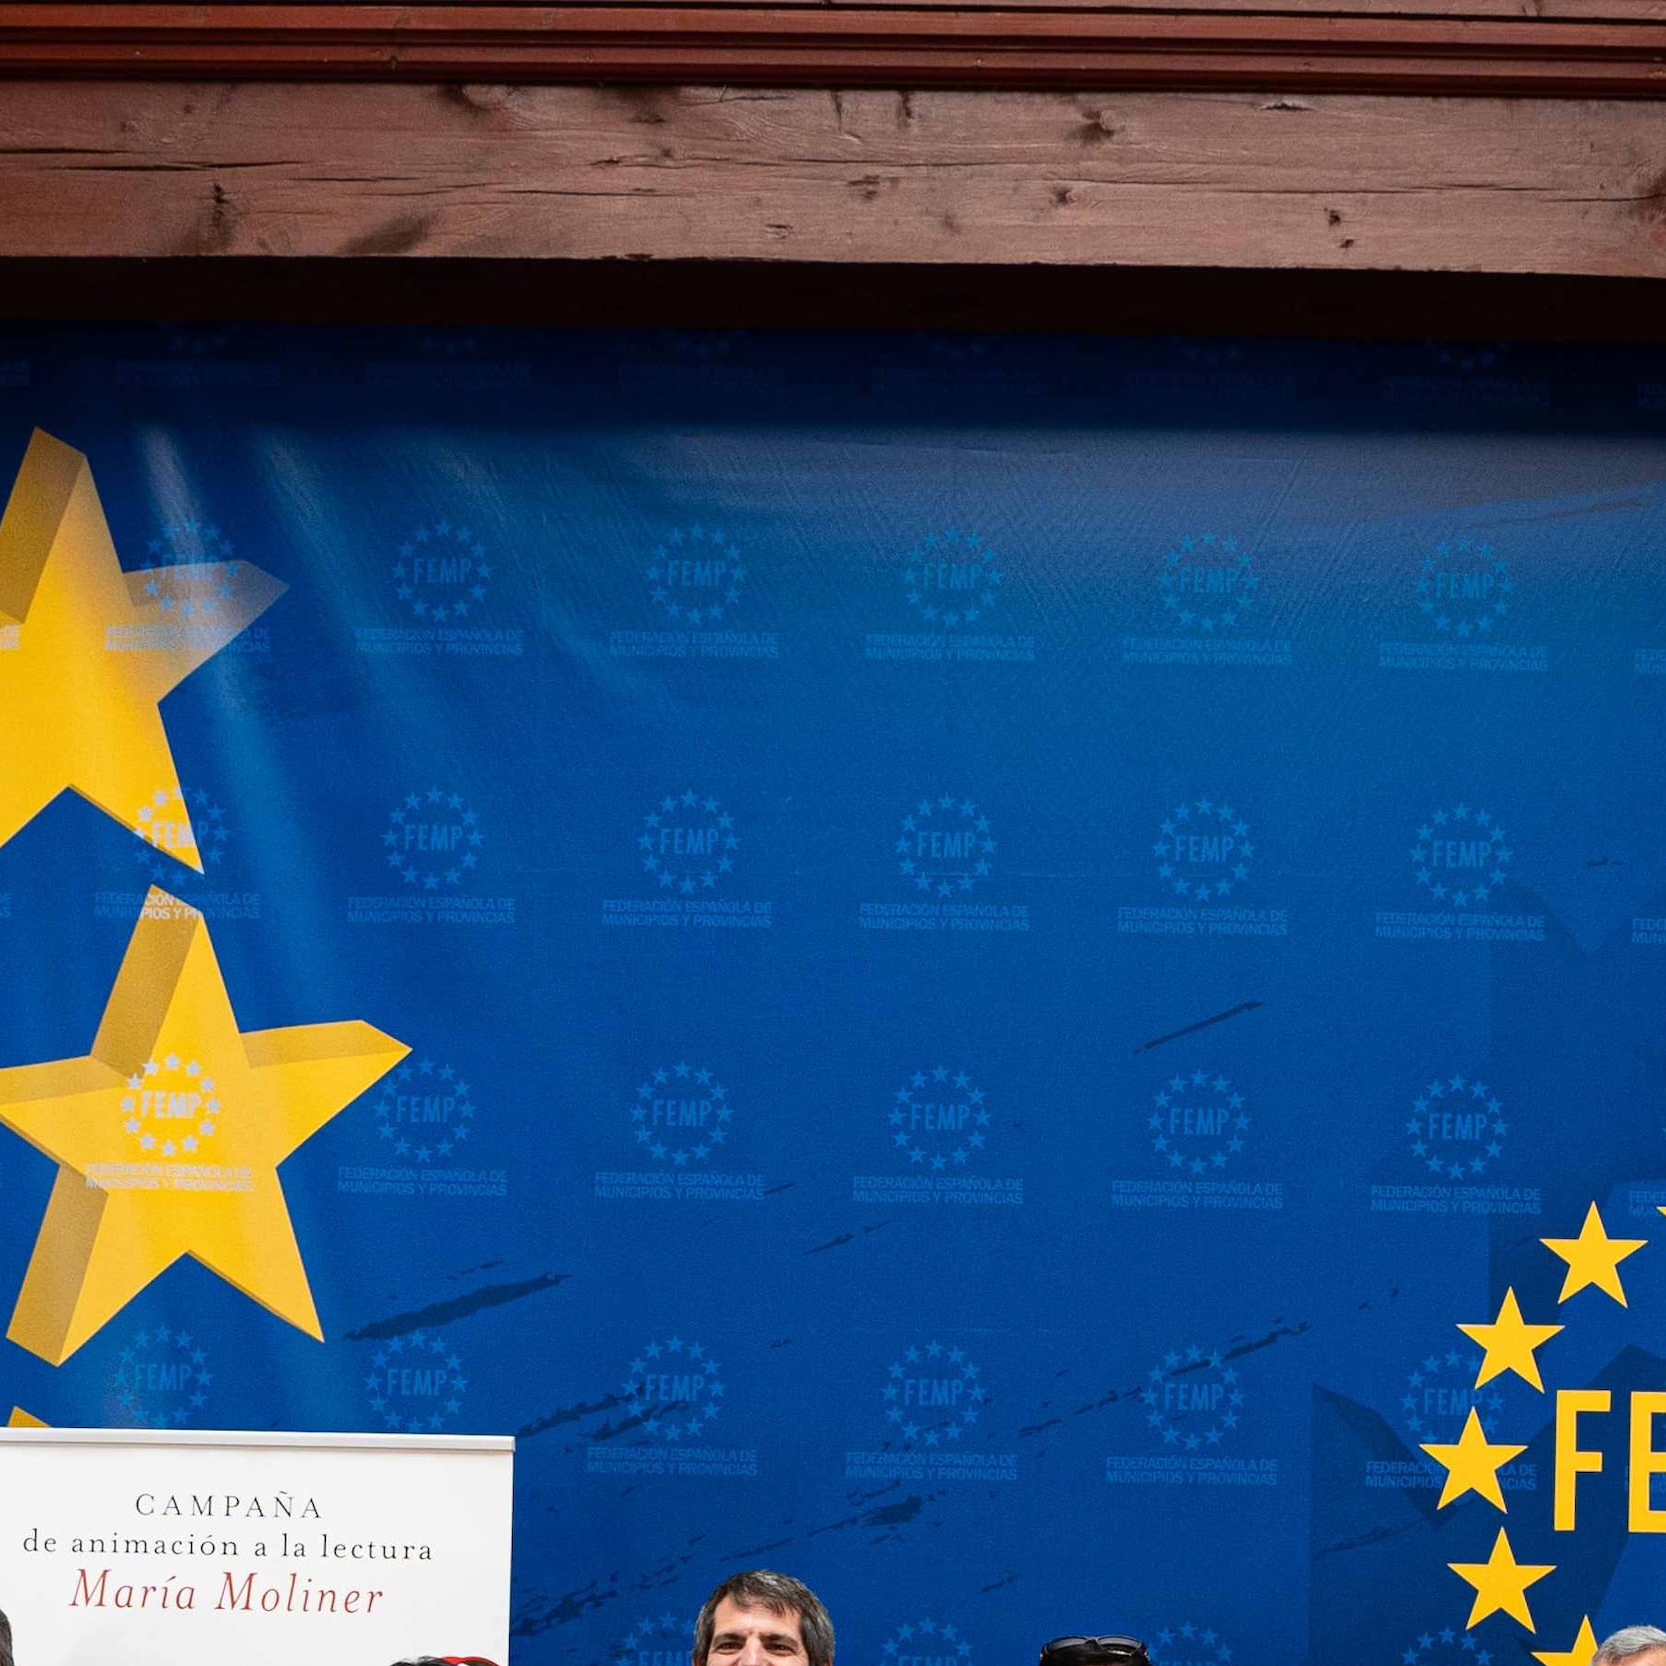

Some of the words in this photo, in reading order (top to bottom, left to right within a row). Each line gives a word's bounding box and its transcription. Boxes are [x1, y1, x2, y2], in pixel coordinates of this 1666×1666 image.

[404, 826, 463, 852] FEMP
[659, 828, 719, 855] FEMP
[917, 830, 976, 858] FEMP
[1175, 836, 1234, 862] FEMP
[1433, 841, 1492, 868] FEMP
[141, 1090, 201, 1118] FEMP
[396, 1097, 455, 1123] FEMP
[652, 1100, 712, 1127] FEMP
[910, 1104, 970, 1131] FEMP
[1169, 1108, 1229, 1136] FEMP
[1429, 1113, 1487, 1140] FEMP
[1006, 1178, 1023, 1191] DE
[1524, 1188, 1541, 1200] DE
[136, 1363, 193, 1390] FEMP
[387, 1370, 446, 1396] FEMP
[645, 1375, 704, 1401] FEMP
[904, 1379, 964, 1406] FEMP
[1164, 1383, 1224, 1410] FEMP
[1260, 1459, 1277, 1471] DE
[135, 1490, 323, 1519] CAMPAÑA
[23, 1529, 58, 1553] de
[71, 1531, 239, 1557] animación
[254, 1541, 268, 1558] a
[281, 1534, 306, 1558] la
[321, 1535, 433, 1560] lectura
[69, 1569, 196, 1610] María
[215, 1572, 384, 1614] Moliner
